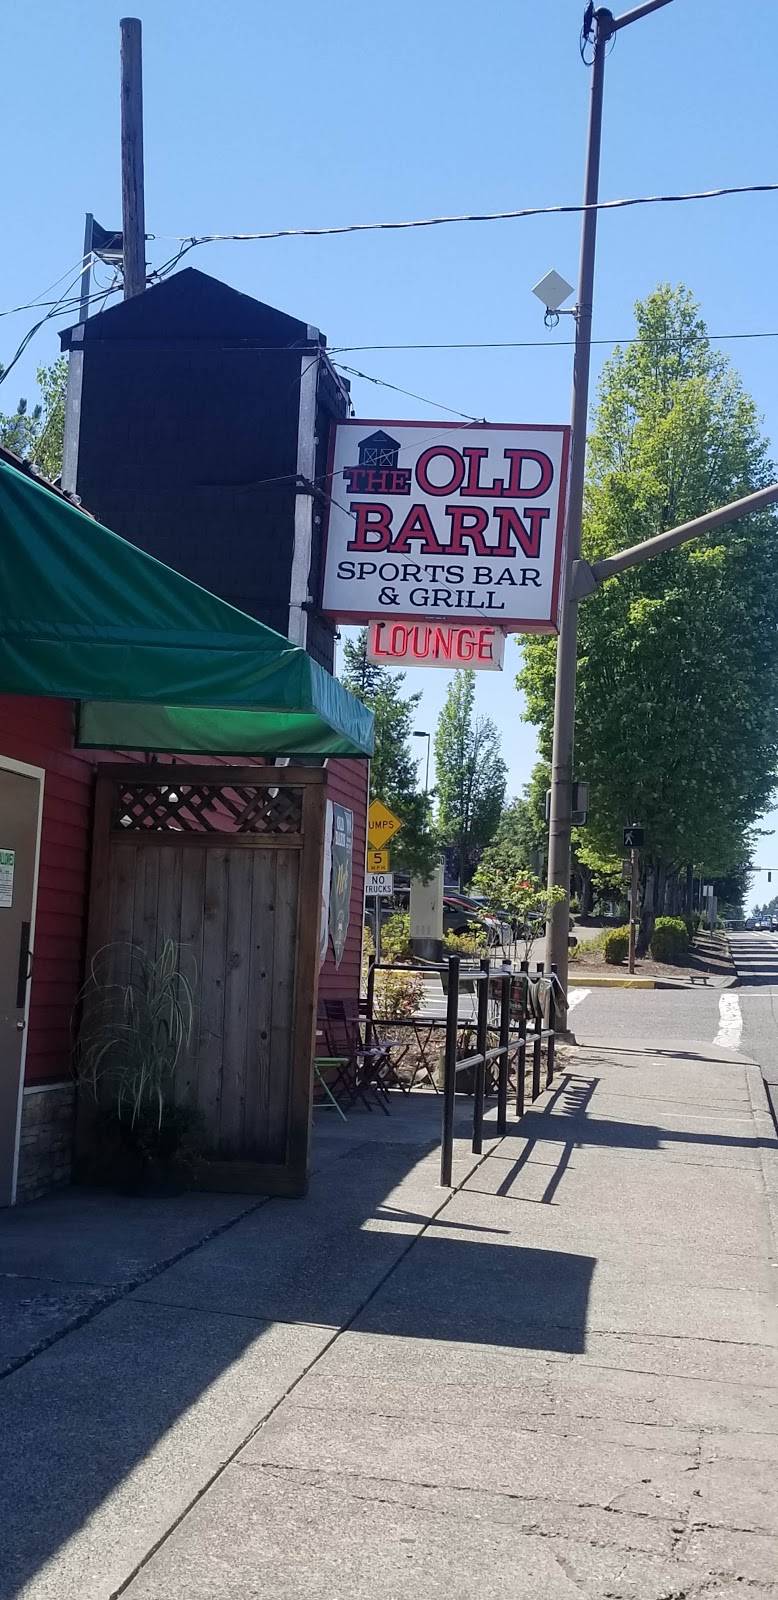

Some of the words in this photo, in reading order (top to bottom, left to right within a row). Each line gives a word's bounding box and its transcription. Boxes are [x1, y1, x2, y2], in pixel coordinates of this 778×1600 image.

[343, 466, 412, 496] THE
[415, 445, 554, 499] OLD
[346, 502, 550, 558] BARN
[337, 561, 464, 584] SPORTS
[472, 566, 542, 587] BAR
[378, 586, 400, 606] &
[409, 588, 505, 609] GRILL
[373, 623, 496, 662] LOUNGE
[368, 821, 394, 830] UMPS
[373, 853, 382, 864] 5
[365, 885, 392, 893] TRUCKS
[371, 876, 385, 885] NO
